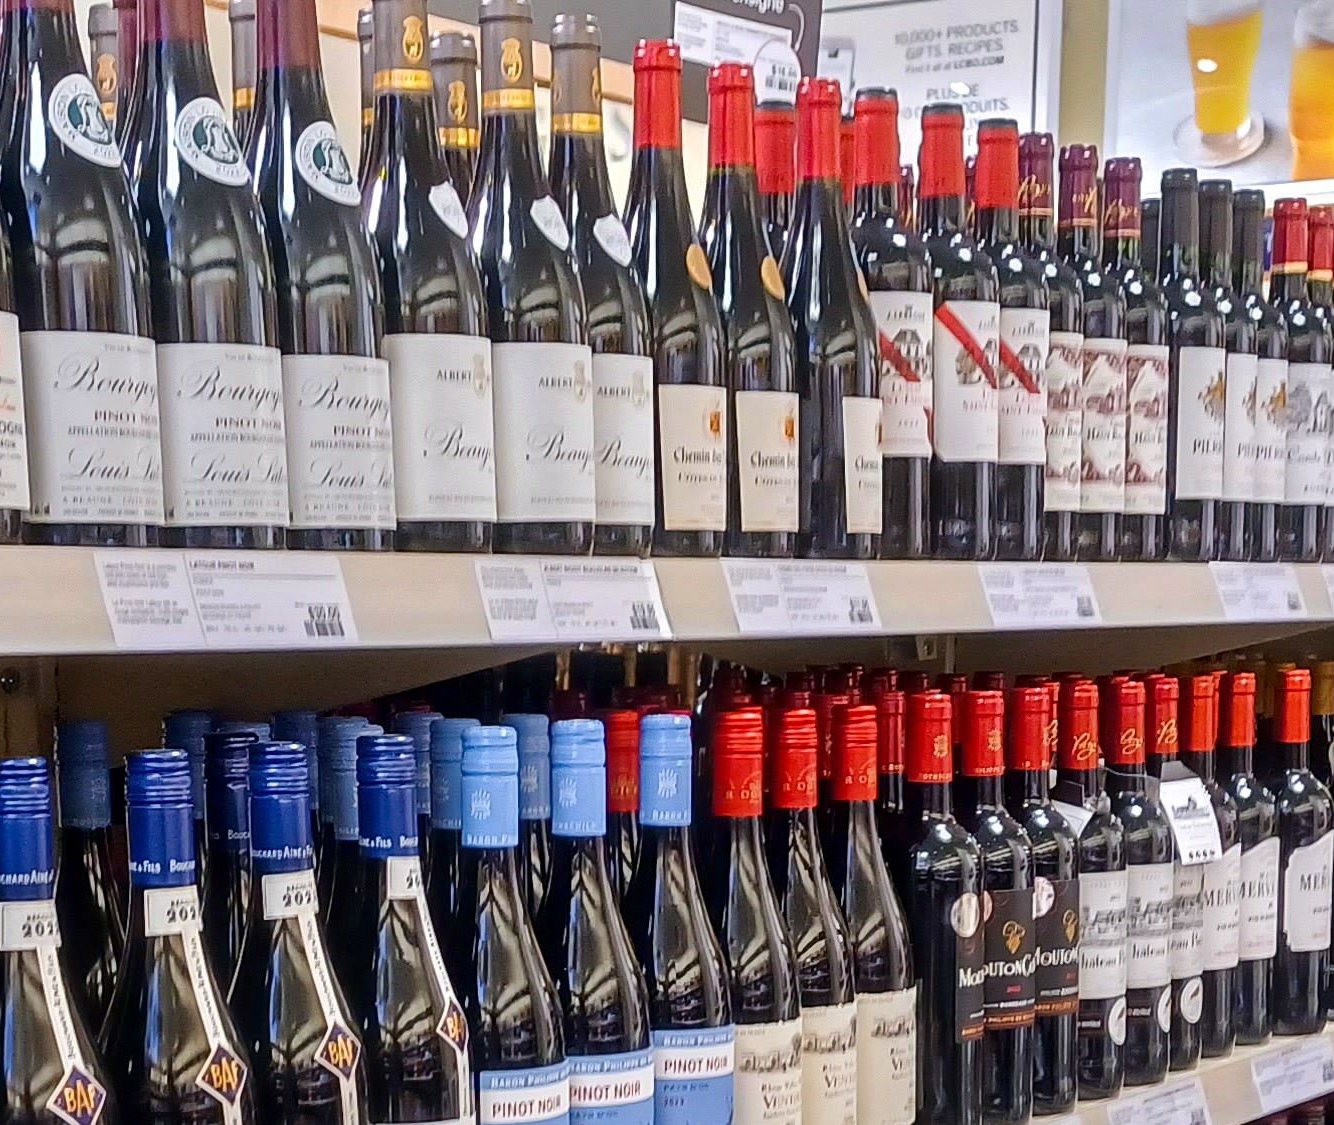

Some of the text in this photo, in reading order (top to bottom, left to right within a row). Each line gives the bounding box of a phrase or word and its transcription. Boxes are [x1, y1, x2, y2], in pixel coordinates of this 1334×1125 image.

[437, 369, 472, 382] ALBERT
[538, 377, 573, 389] ALBERT
[597, 385, 632, 398] ALBERT
[95, 410, 136, 423] PINOT
[216, 417, 257, 429] PINOT
[332, 424, 371, 436] PINOT
[69, 448, 130, 478] Louis
[191, 451, 251, 482] Louis
[310, 457, 365, 488] Louis
[983, 960, 1023, 979] OUTON
[663, 1057, 728, 1074] PINOT NOIR
[569, 1080, 641, 1103] PINOT NOIR
[492, 1098, 562, 1119] PINOT NOIR
